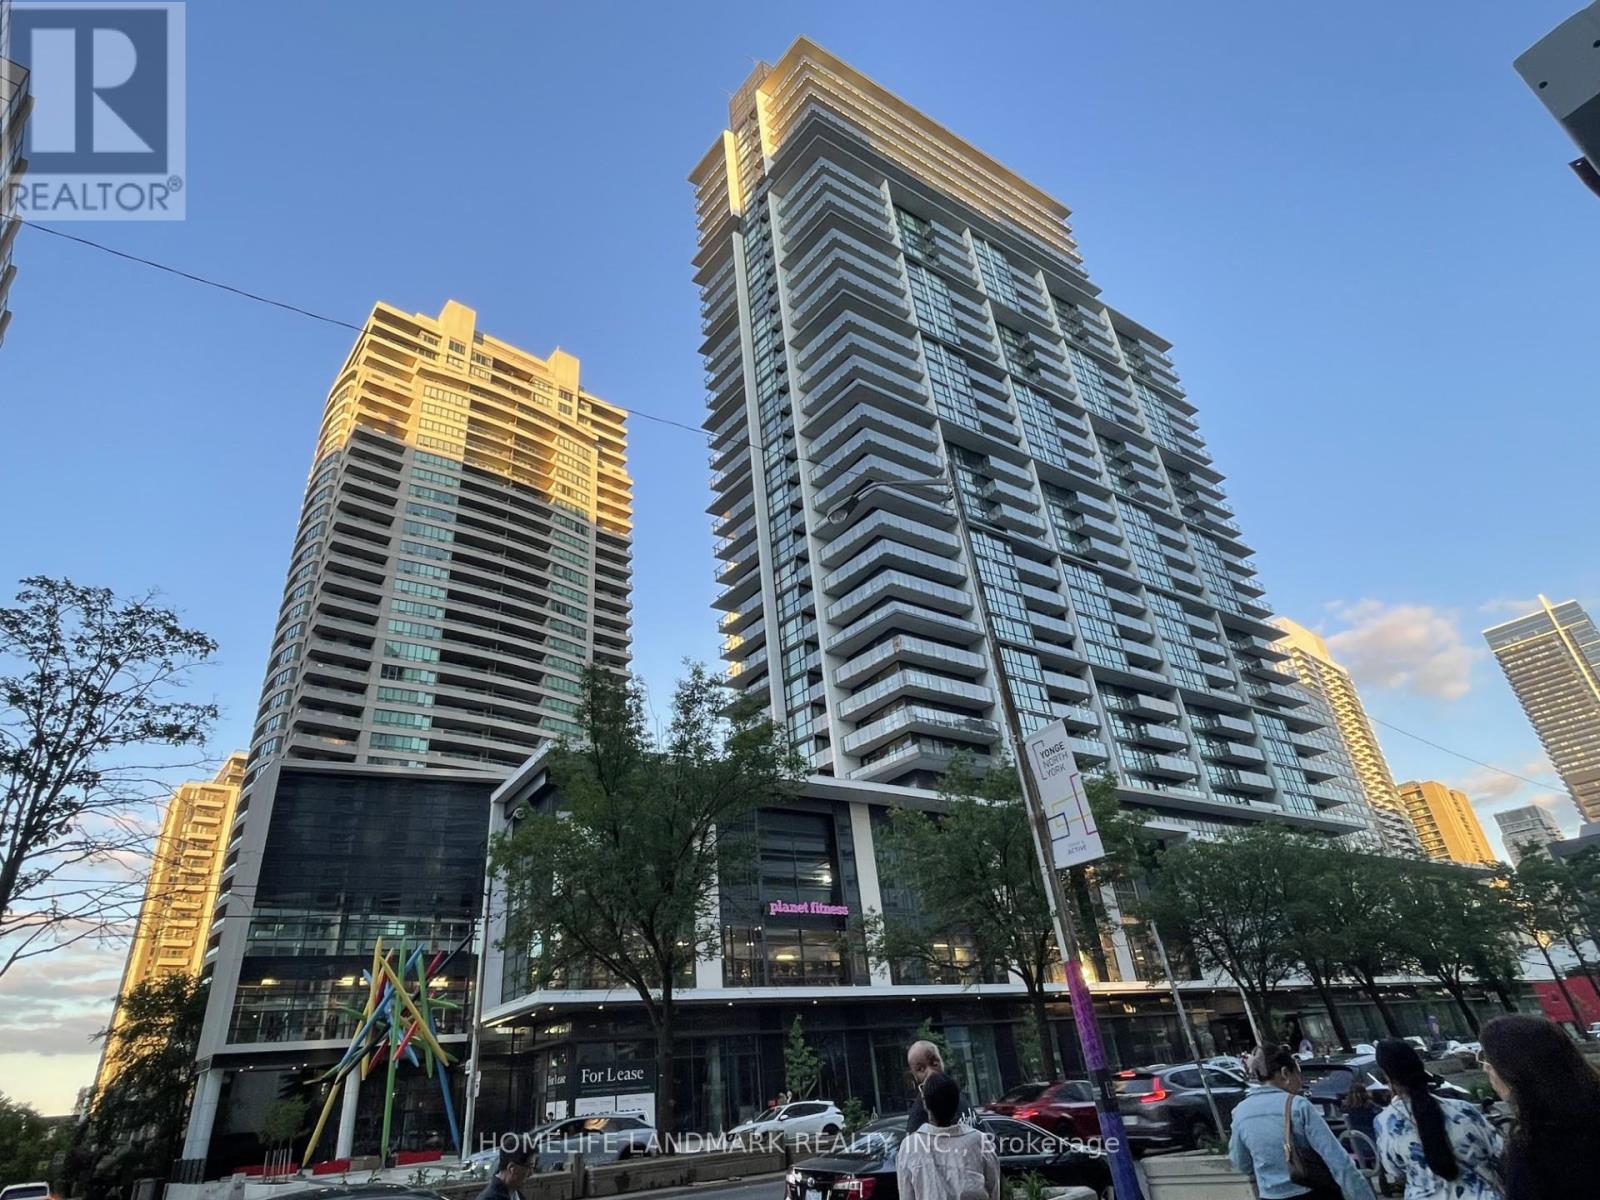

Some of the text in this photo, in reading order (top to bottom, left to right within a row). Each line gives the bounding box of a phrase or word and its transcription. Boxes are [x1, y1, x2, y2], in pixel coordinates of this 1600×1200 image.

[1040, 741, 1065, 759] YONGE
[1042, 751, 1069, 769] NORTH
[1046, 763, 1066, 777] YORK
[769, 900, 849, 915] planet fitness
[581, 1067, 644, 1084] For Lease
